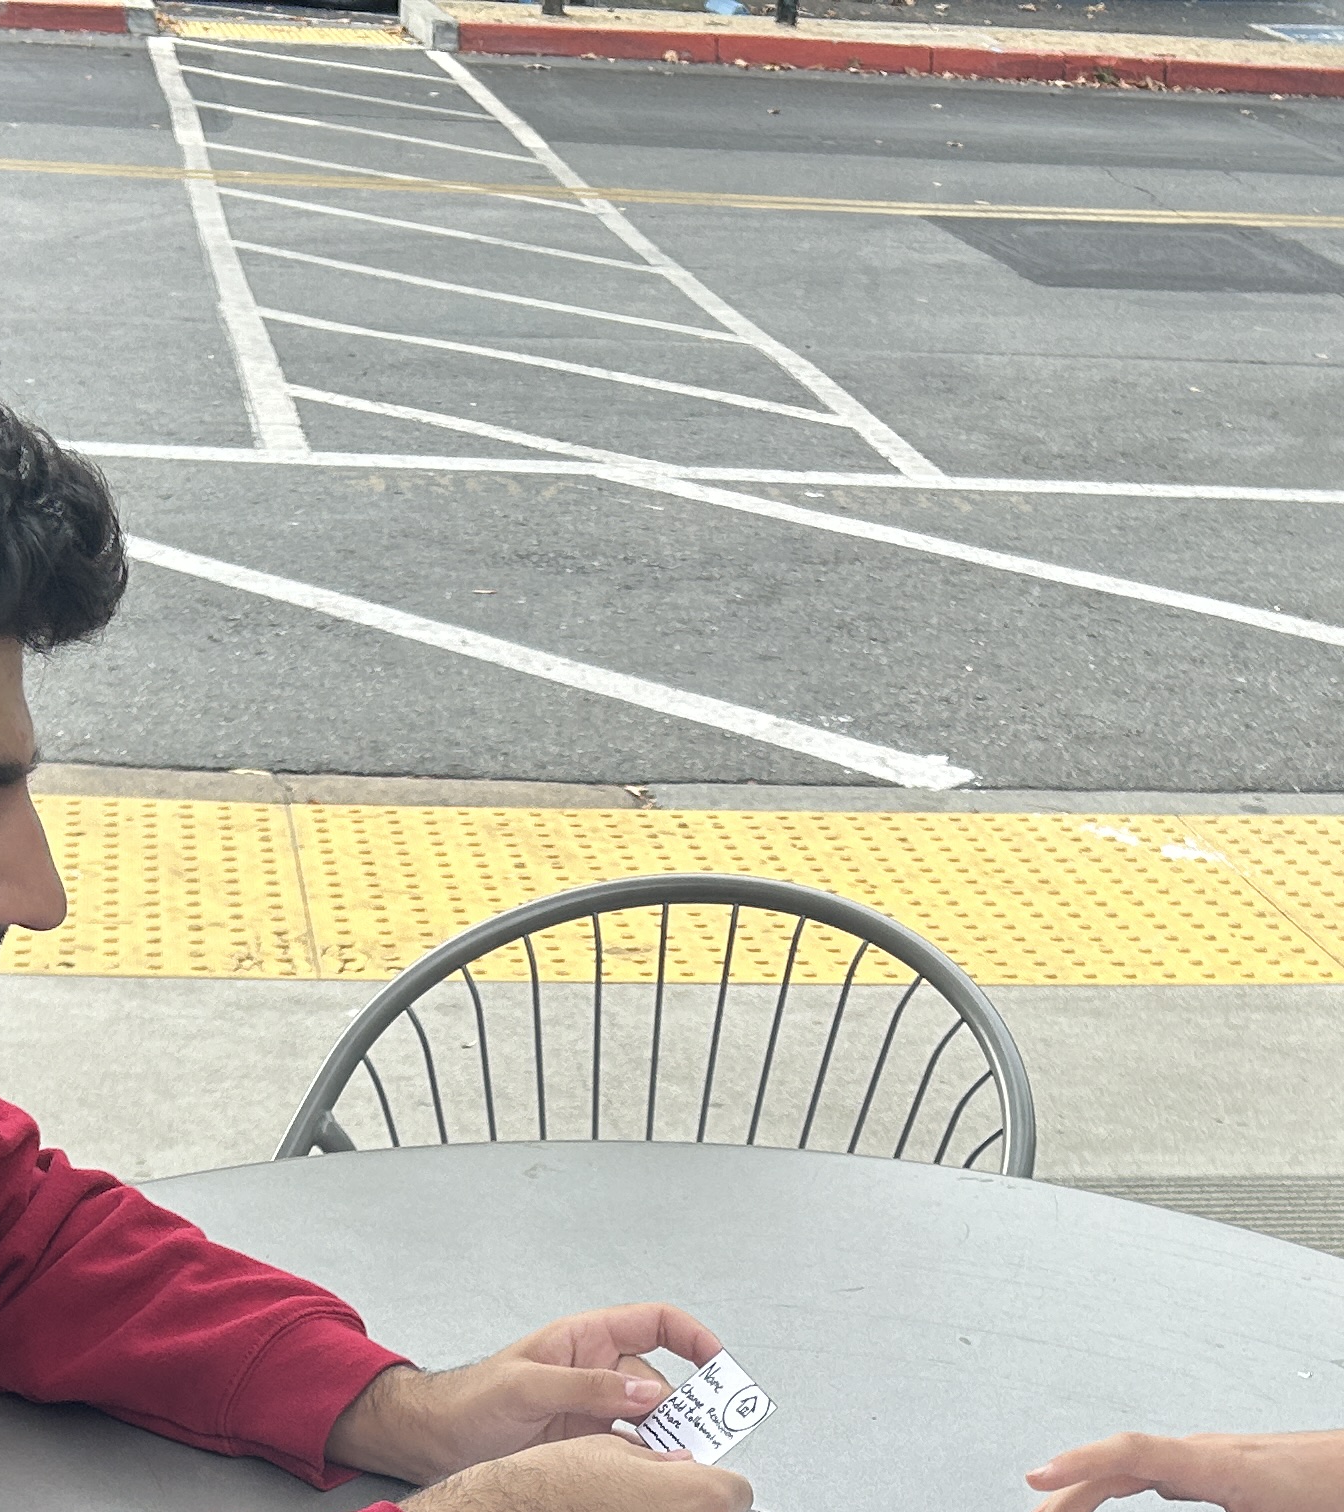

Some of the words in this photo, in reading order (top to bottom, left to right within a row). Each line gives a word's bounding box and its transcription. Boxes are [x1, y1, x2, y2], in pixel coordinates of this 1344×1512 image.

[698, 1362, 724, 1394] Name
[668, 1396, 687, 1412] Add
[681, 1384, 704, 1411] Change
[657, 1404, 681, 1429] Share
